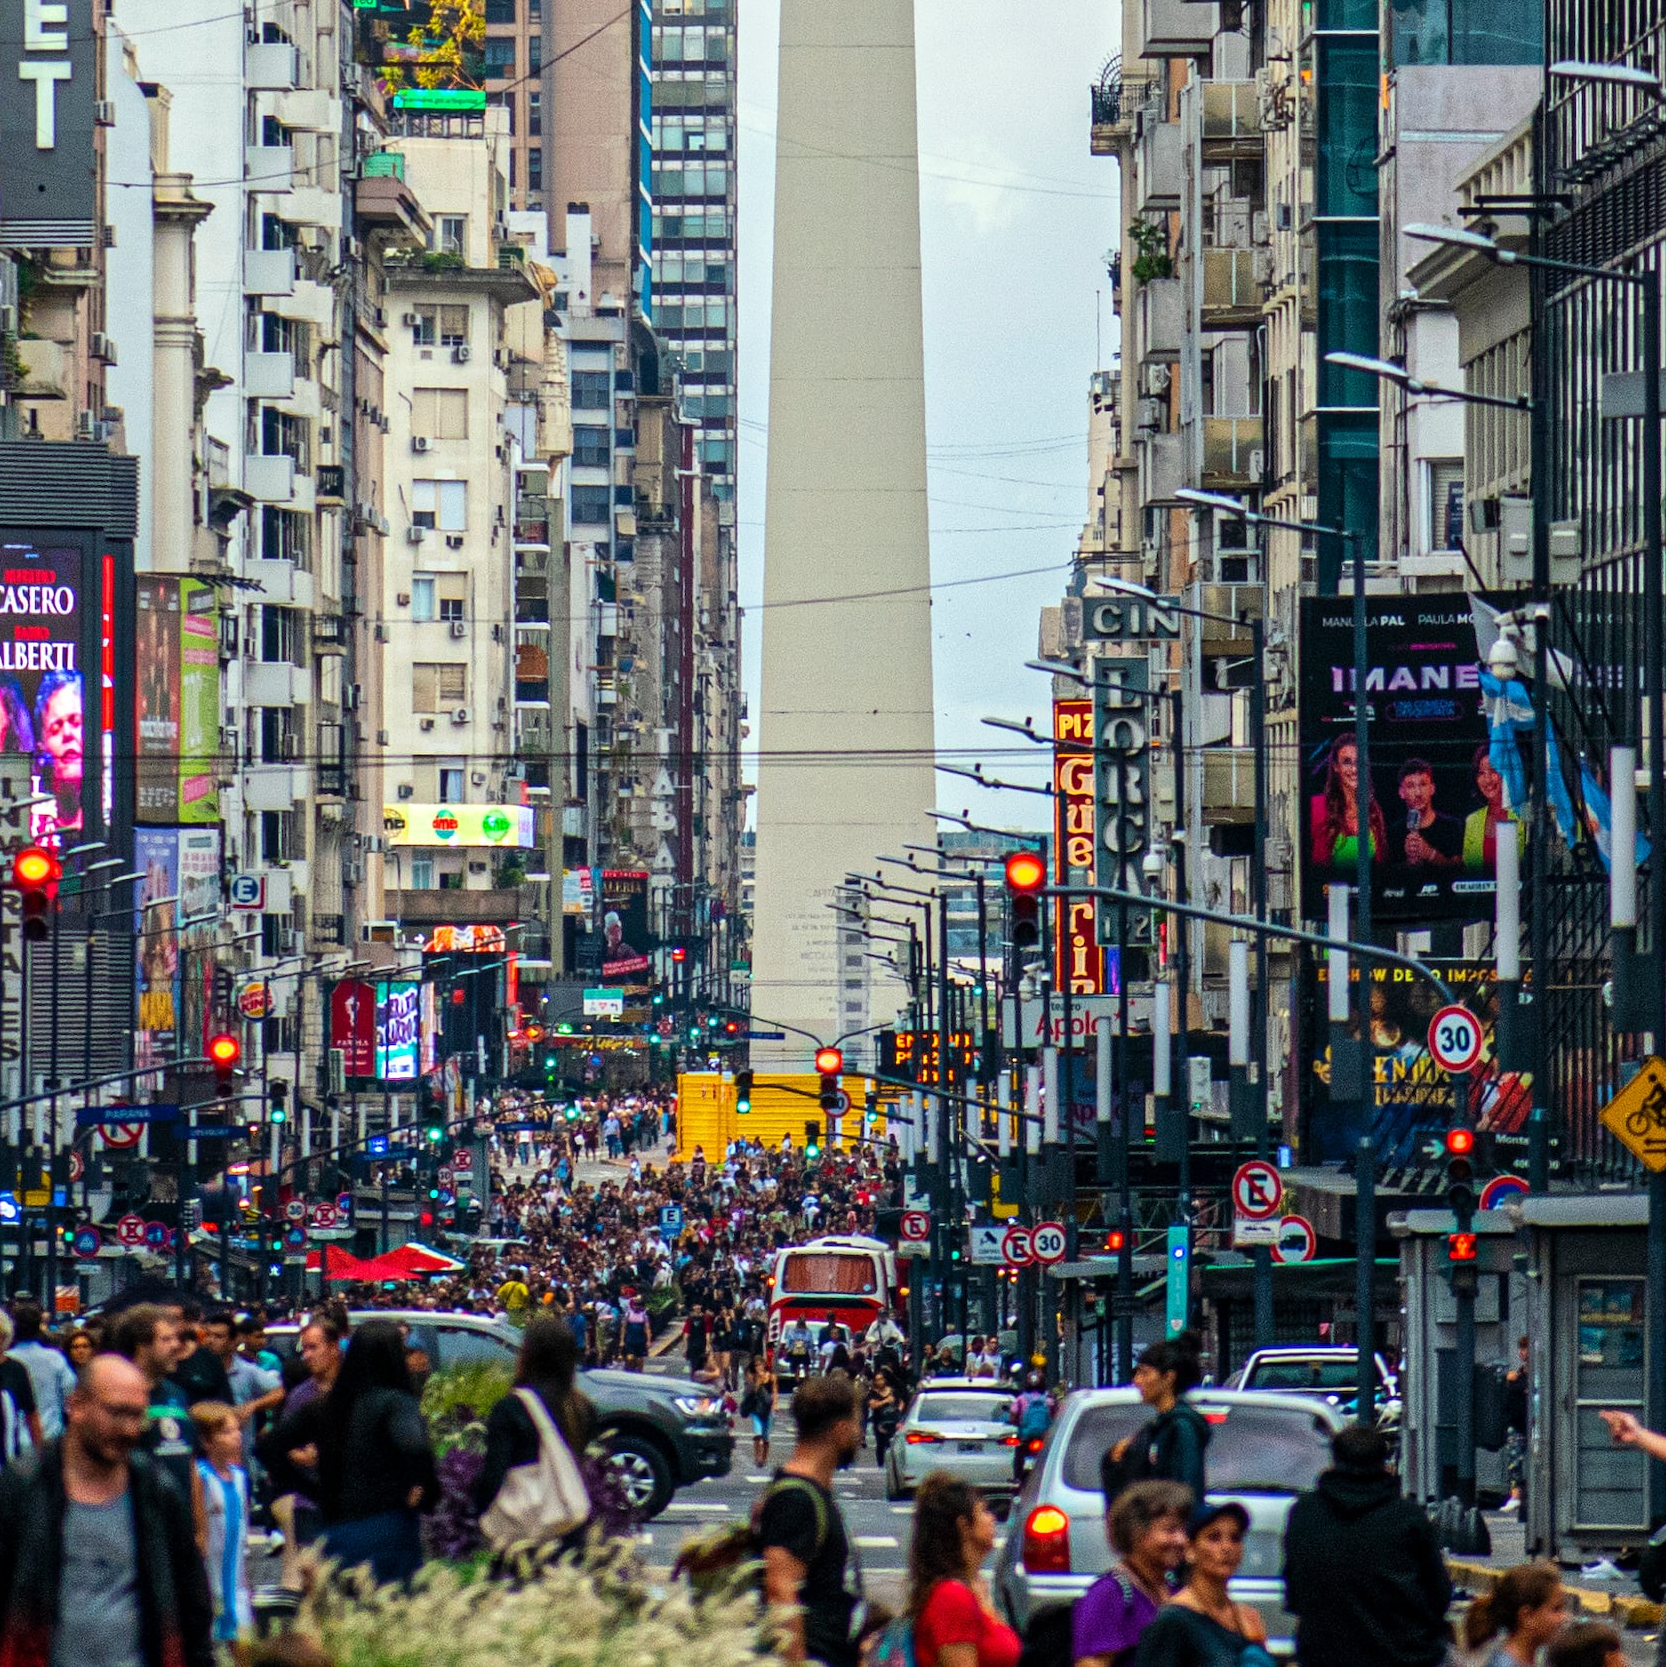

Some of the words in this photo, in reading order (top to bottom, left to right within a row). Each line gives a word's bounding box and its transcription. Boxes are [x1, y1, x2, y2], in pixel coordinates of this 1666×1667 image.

[1092, 603, 1180, 635] CIN
[1322, 615, 1379, 628] MANULA
[1380, 615, 1406, 626] PAL
[1418, 613, 1455, 626] PAULA
[1457, 613, 1475, 624] MO
[1331, 664, 1480, 692] IMANE
[1058, 711, 1094, 741] PIZ
[1102, 666, 1146, 896] LORCA
[237, 878, 254, 898] E
[1393, 968, 1414, 982] DE
[1050, 1001, 1082, 1012] tearo
[1440, 1025, 1471, 1053] 30
[1038, 1234, 1061, 1252] 30
